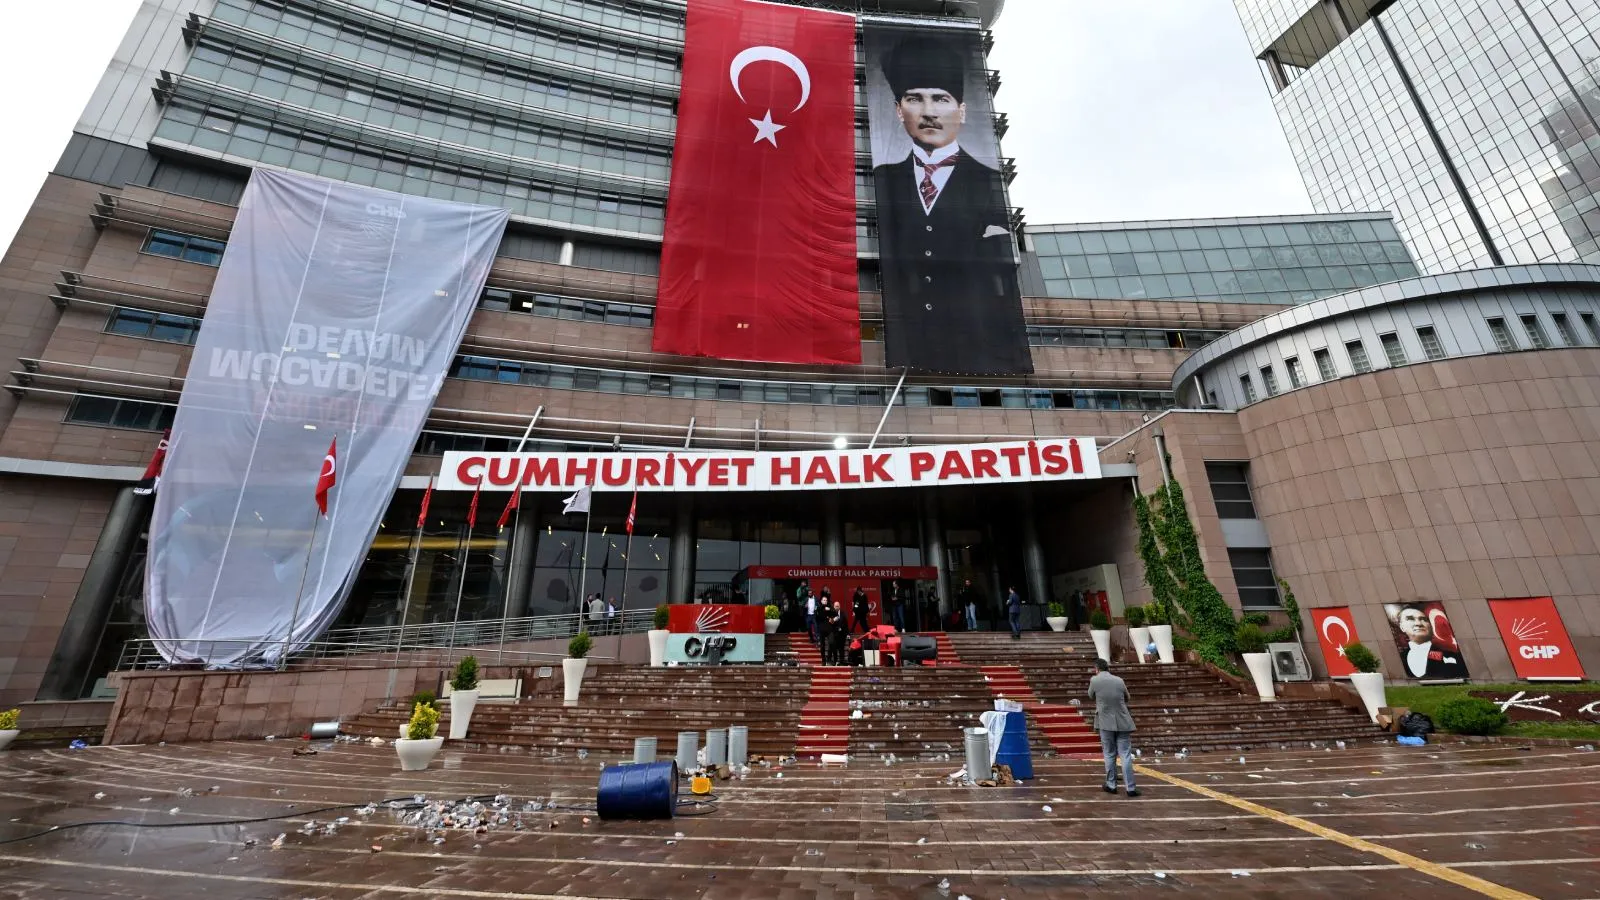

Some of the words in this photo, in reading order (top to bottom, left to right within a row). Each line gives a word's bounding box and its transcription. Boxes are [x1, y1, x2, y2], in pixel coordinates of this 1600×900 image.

[456, 452, 755, 487] CUMHURİYET
[770, 453, 894, 485] HALK
[909, 438, 1084, 481] PARTİSİ
[787, 568, 842, 577] CUMHURİYET
[844, 569, 866, 577] HALK
[869, 568, 901, 577] PARTİSİ
[1519, 645, 1560, 659] CHP
